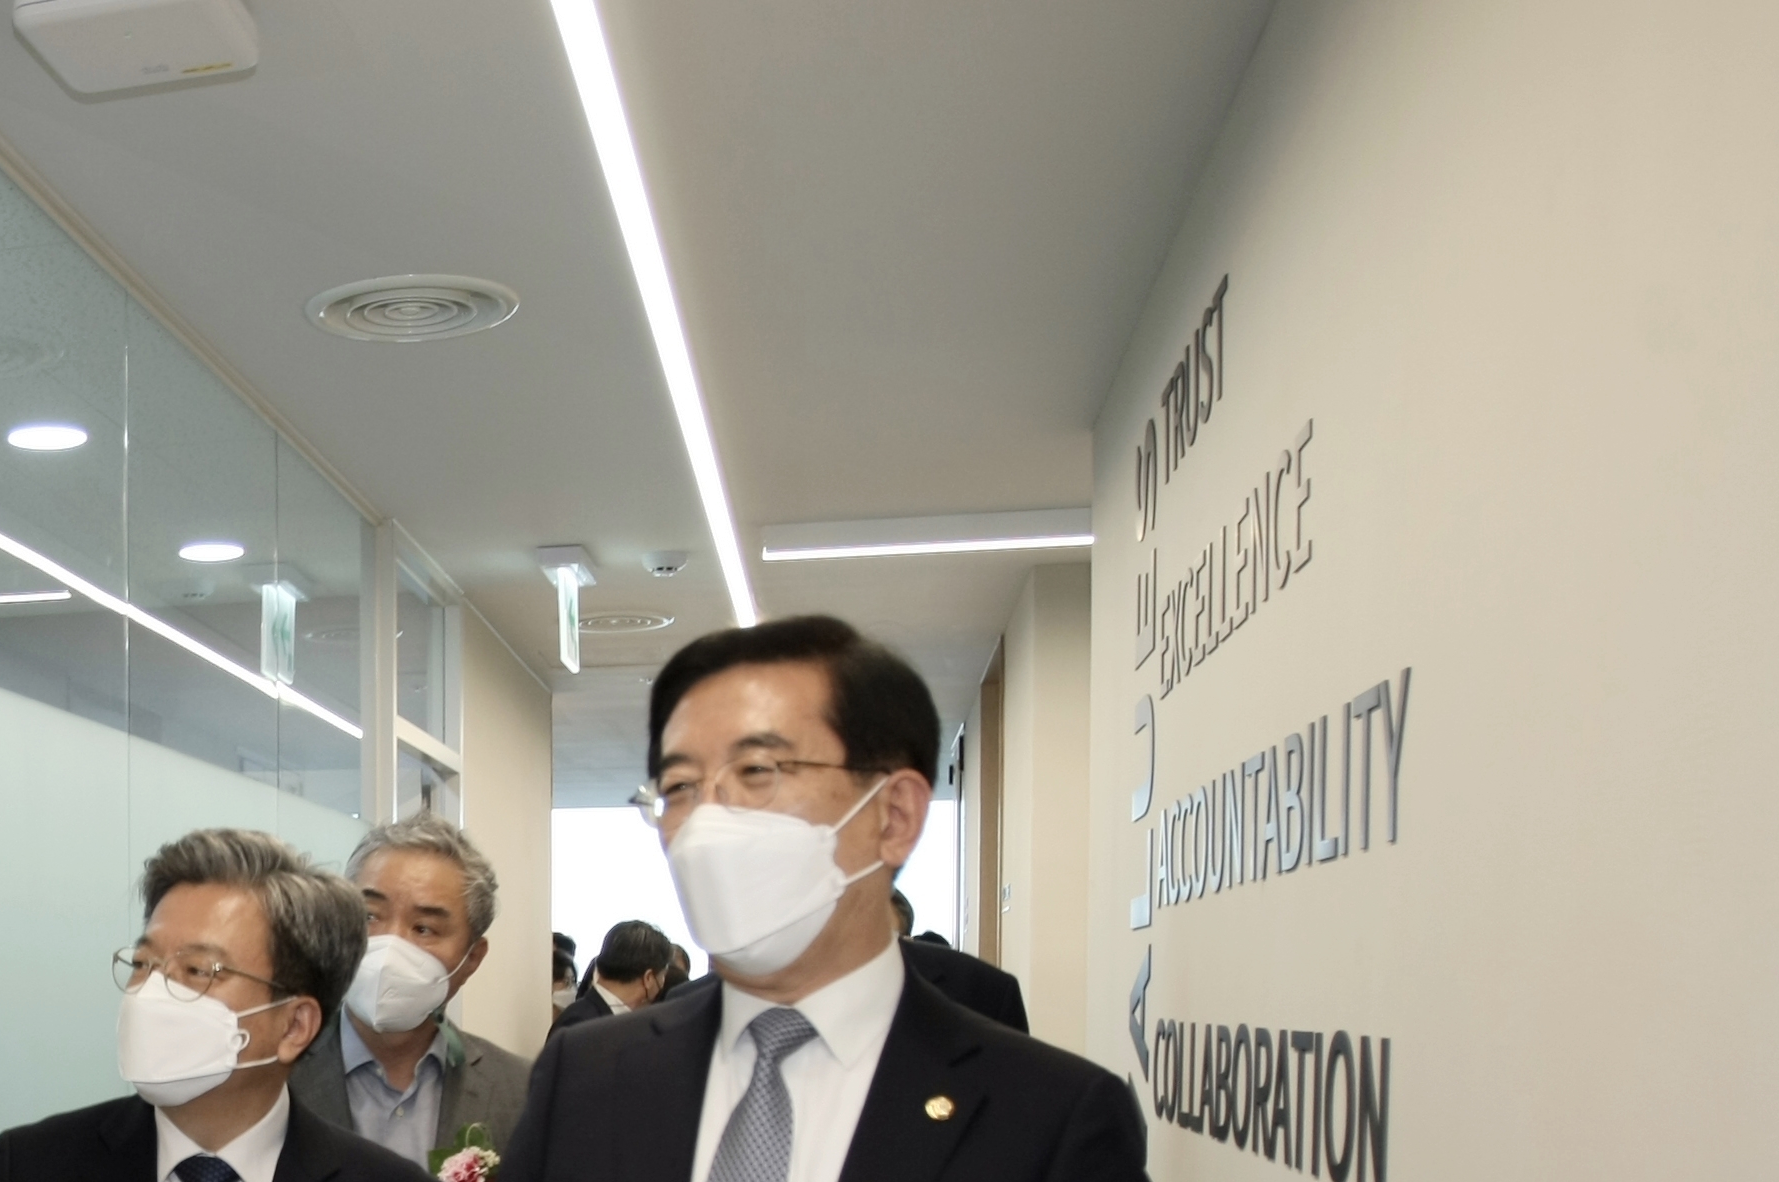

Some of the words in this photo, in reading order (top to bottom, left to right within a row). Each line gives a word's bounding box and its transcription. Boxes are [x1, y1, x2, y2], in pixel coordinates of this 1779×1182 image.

[1161, 273, 1229, 484] TRUST
[1160, 418, 1313, 700] EXCELLENCE
[1157, 667, 1412, 909] ACCOUNTABILITY
